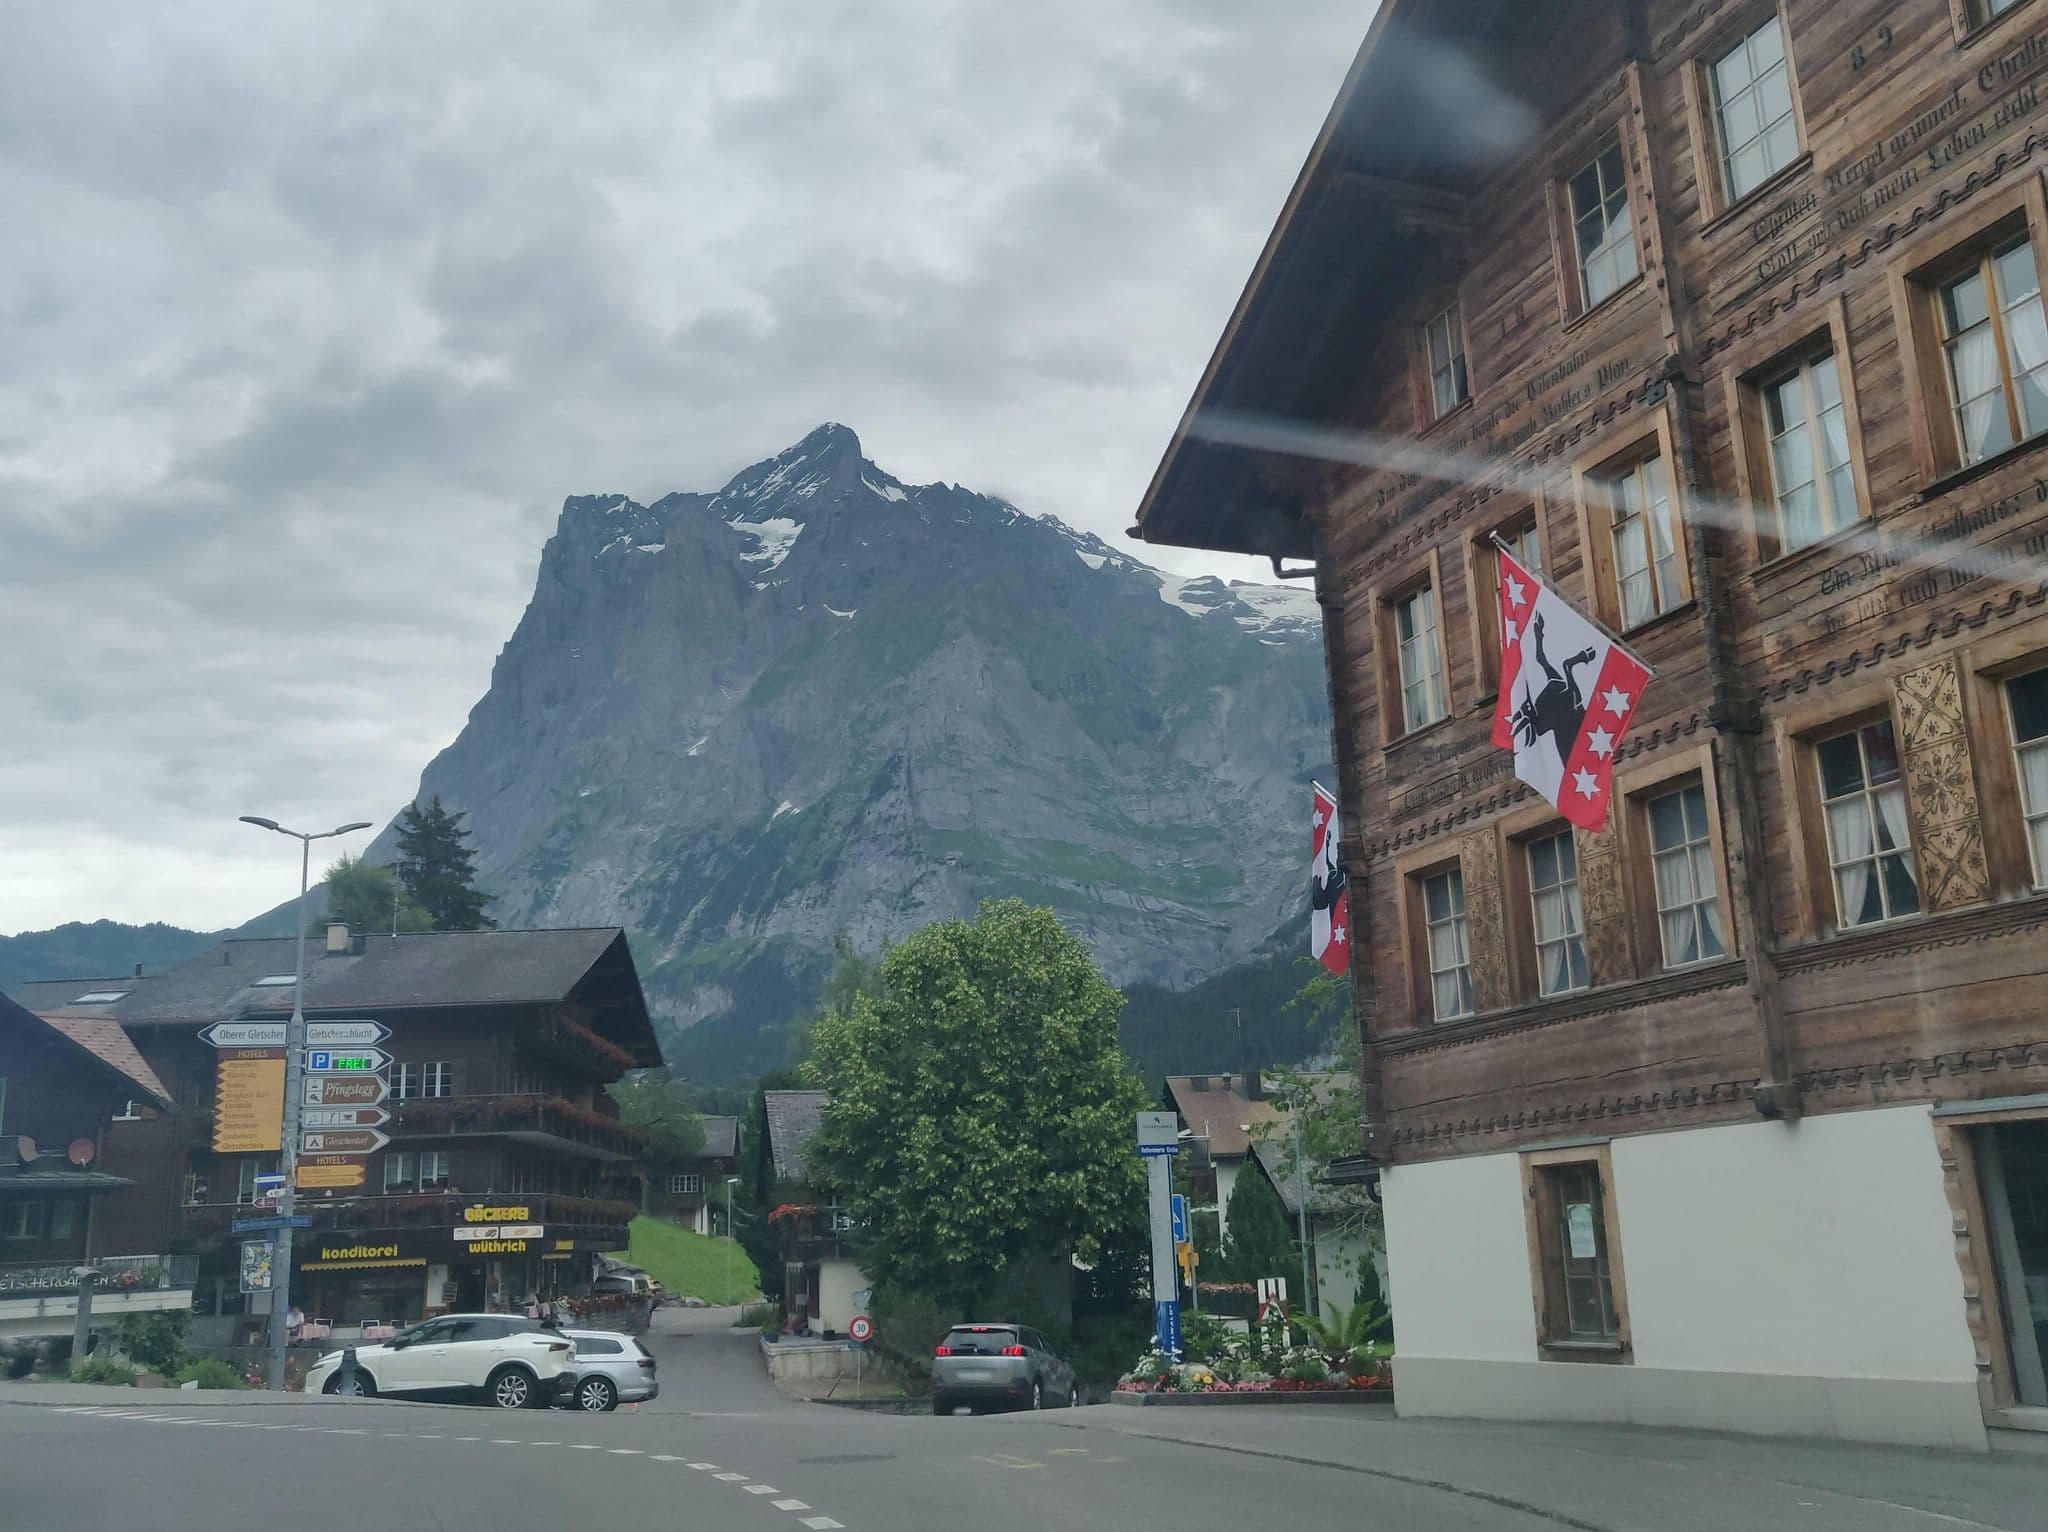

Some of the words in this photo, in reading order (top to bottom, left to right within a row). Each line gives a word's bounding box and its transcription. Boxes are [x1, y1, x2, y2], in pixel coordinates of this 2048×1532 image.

[219, 1030, 247, 1040] Oberer
[248, 1029, 285, 1041] Gletscher
[238, 1049, 268, 1058] HOTELS
[316, 1054, 326, 1067] P
[324, 1081, 375, 1097] Pfingstegg
[316, 1155, 346, 1165] HOTELS
[321, 1244, 398, 1260] konditorei
[468, 1240, 526, 1254] wüthrich
[855, 1323, 866, 1333] 30
